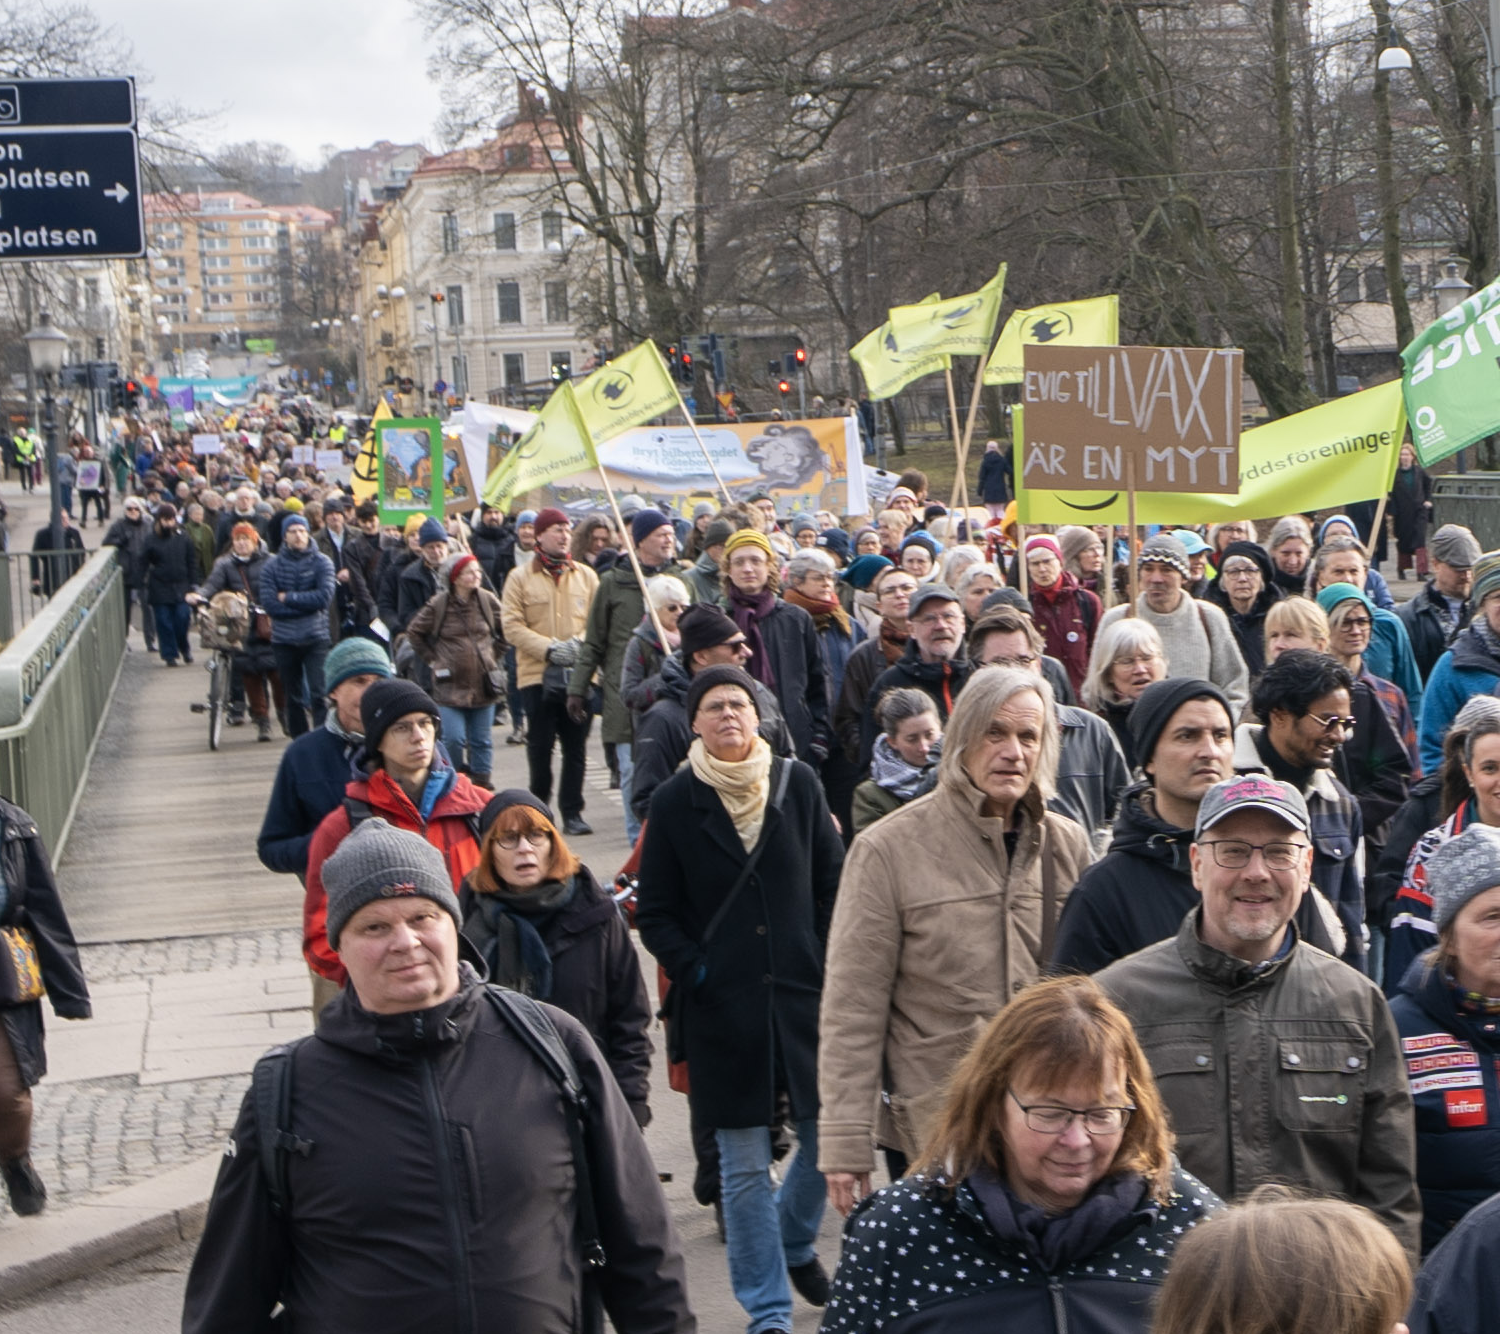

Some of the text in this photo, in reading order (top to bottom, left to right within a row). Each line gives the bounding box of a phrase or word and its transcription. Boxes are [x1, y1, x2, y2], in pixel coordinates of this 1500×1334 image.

[1025, 369, 1070, 404] EVIG
[1023, 441, 1235, 486] ÄR EN MYT
[1238, 430, 1397, 487] yddsföreninge
